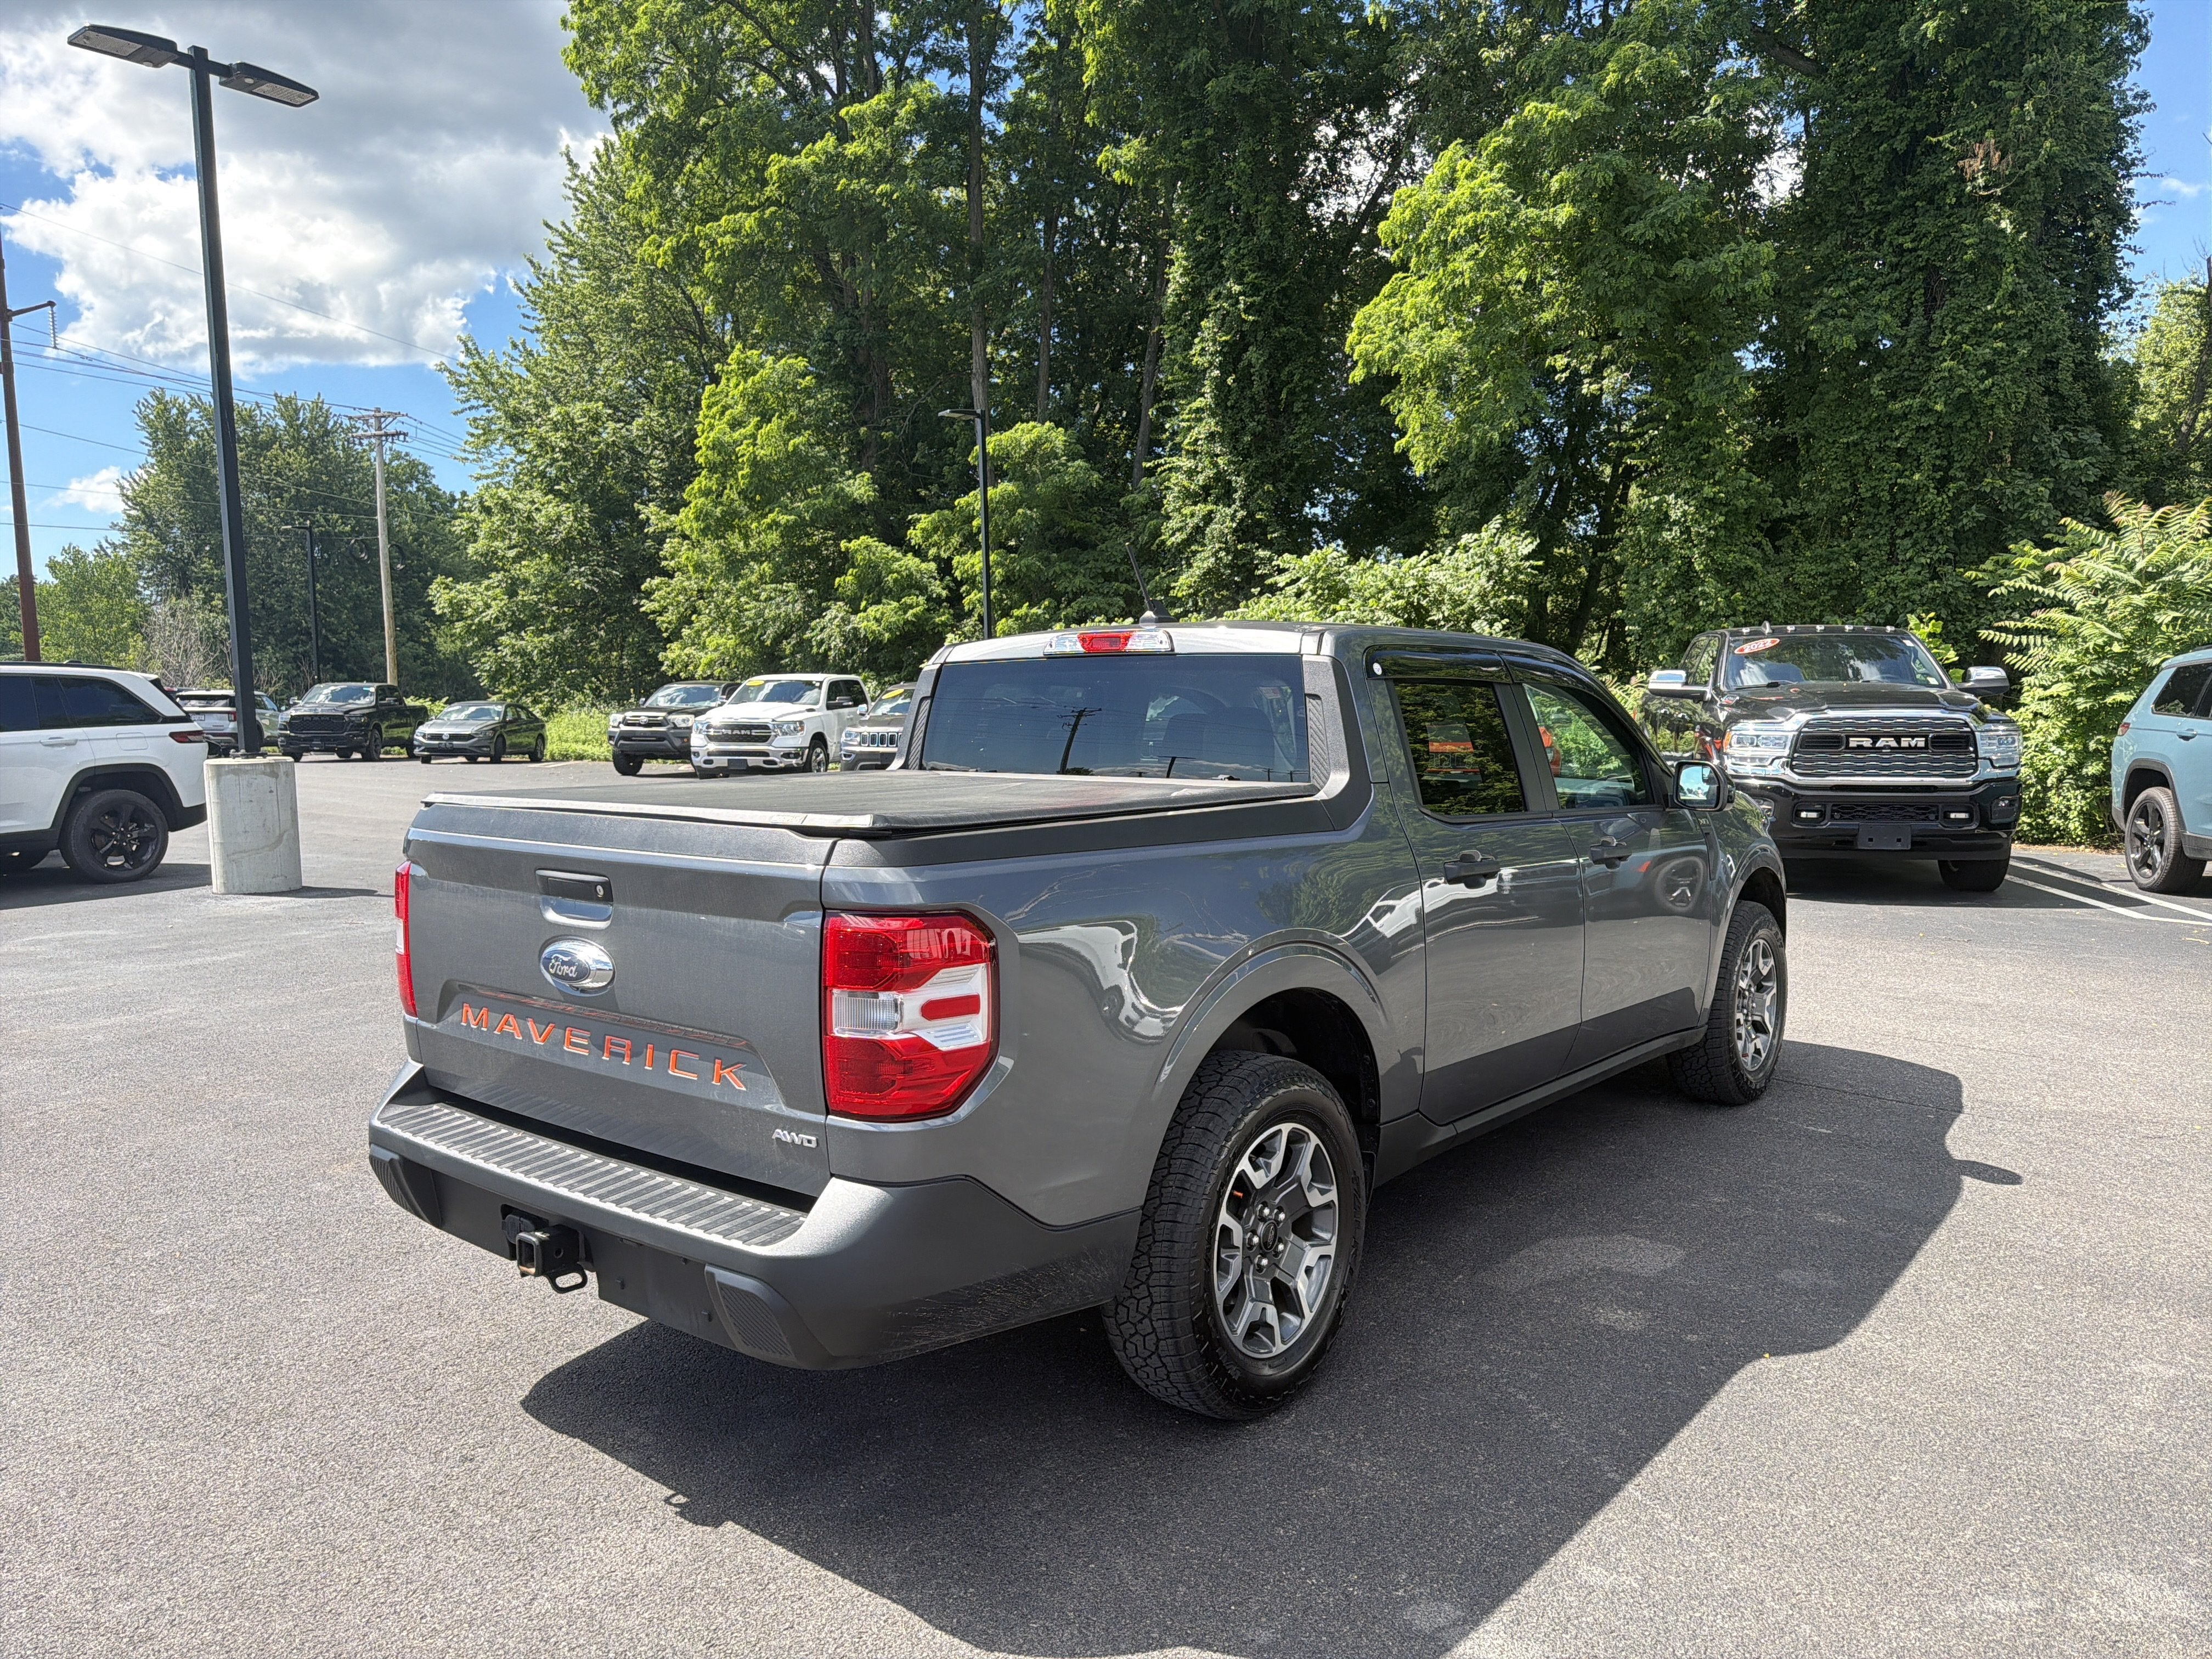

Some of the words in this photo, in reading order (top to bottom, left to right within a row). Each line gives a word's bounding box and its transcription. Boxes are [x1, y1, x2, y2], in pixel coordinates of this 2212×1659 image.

[1745, 640, 1771, 651] 2022
[1849, 738, 1926, 747] RAM
[549, 953, 578, 978] Ford
[460, 1003, 747, 1091] MAVERICK
[771, 1128, 817, 1148] AWD
